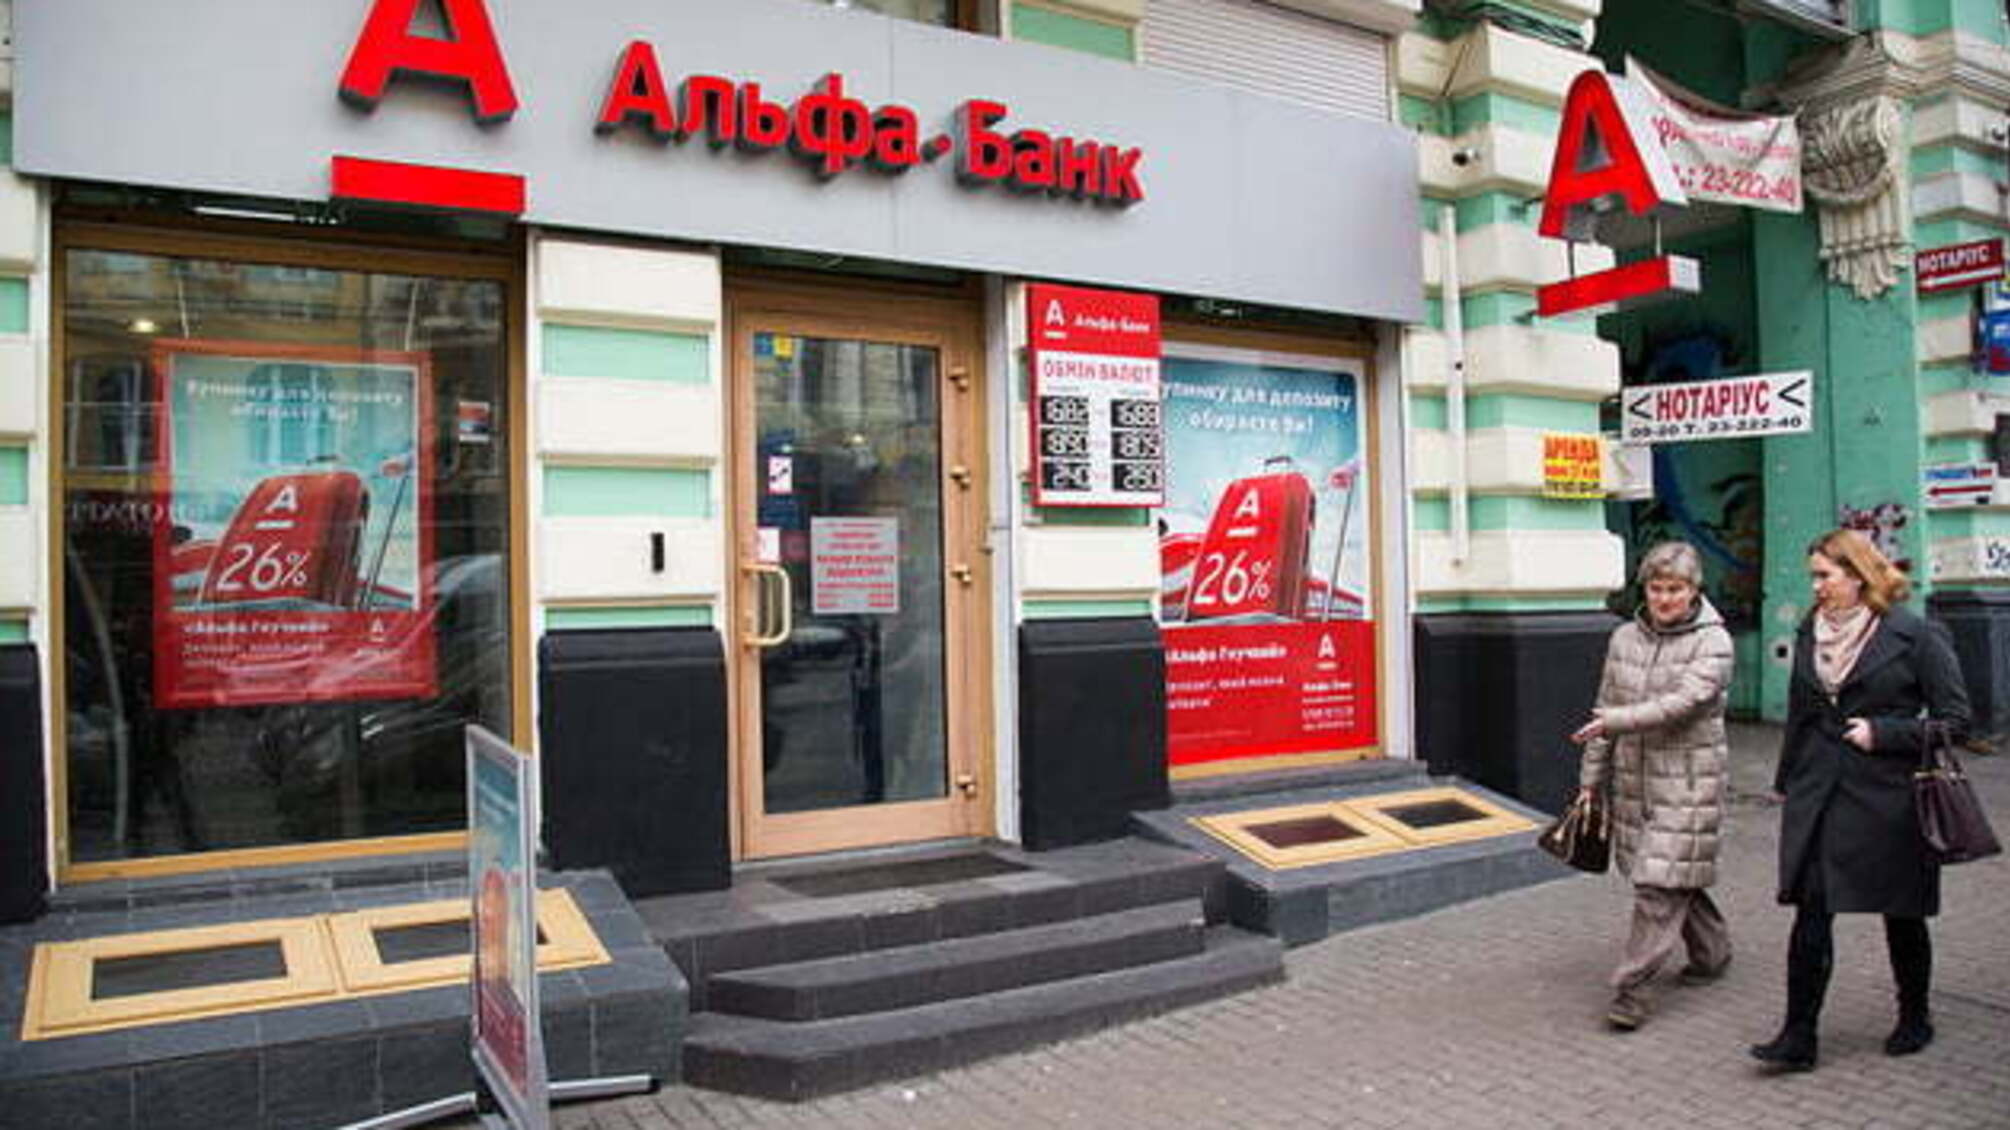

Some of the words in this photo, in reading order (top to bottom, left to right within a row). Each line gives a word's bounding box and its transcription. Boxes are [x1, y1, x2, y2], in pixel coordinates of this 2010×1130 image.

[1161, 381, 1227, 403] упинку
[1656, 380, 1771, 422] НОТАРІУС
[216, 542, 312, 592] 26%
[1193, 551, 1272, 606] 26%
